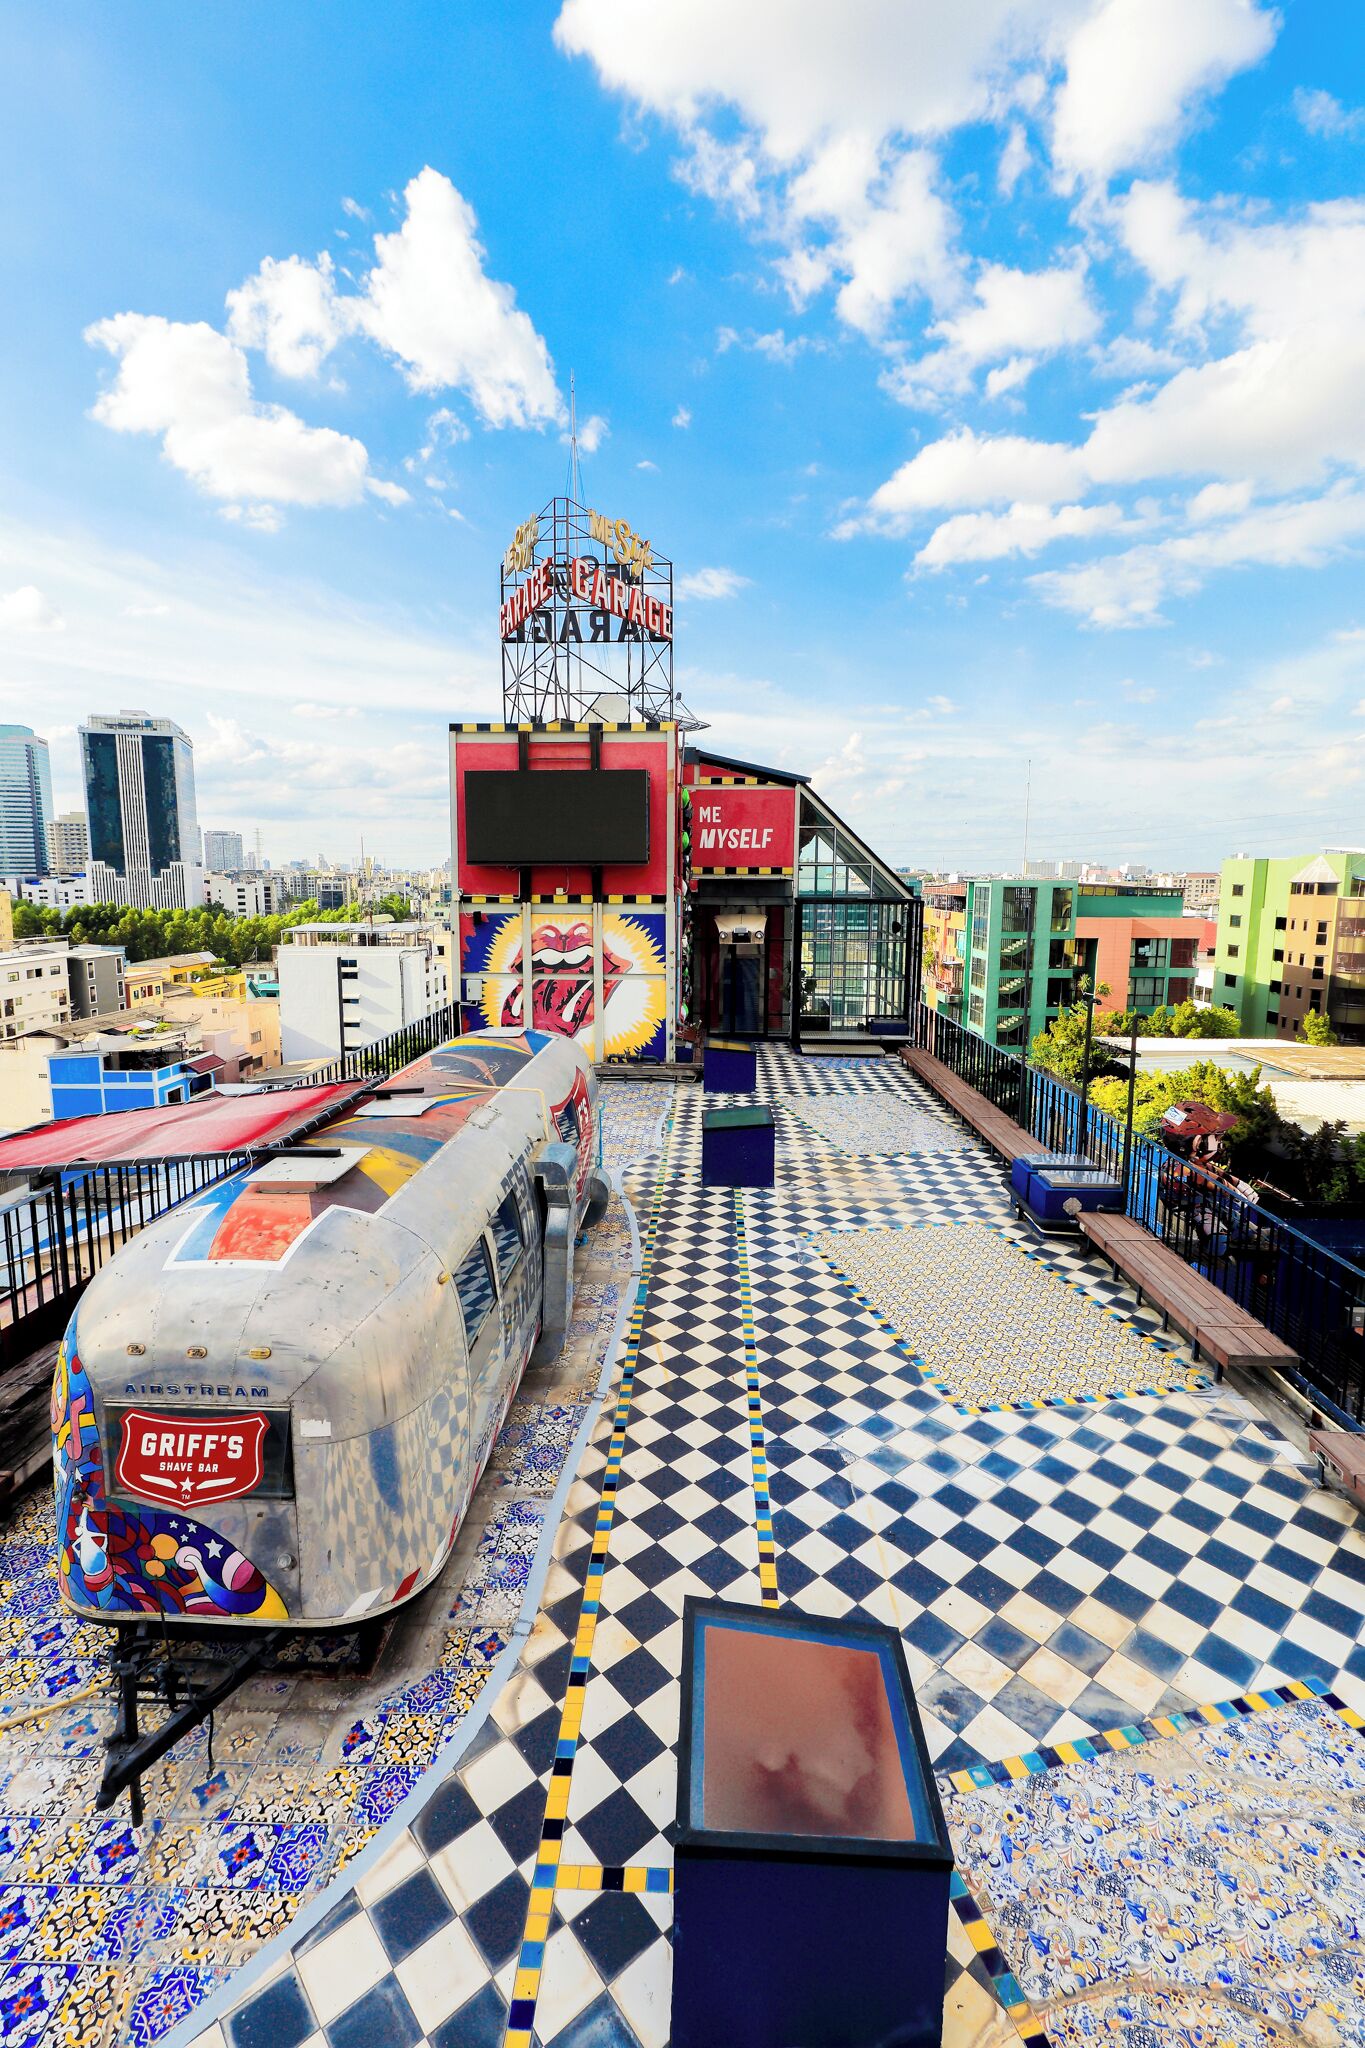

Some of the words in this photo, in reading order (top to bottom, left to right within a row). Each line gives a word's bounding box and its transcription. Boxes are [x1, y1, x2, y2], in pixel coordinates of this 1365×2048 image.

[588, 509, 613, 548] ME
[499, 557, 554, 640] GARAGE
[572, 557, 672, 641] GARAGE
[699, 806, 722, 823] ME
[699, 828, 774, 849] MYSELF
[125, 1383, 269, 1397] AIRSTREAM
[140, 1433, 244, 1459] GRIFF'S
[159, 1462, 193, 1472] SHAVE
[198, 1463, 219, 1473] BAR
